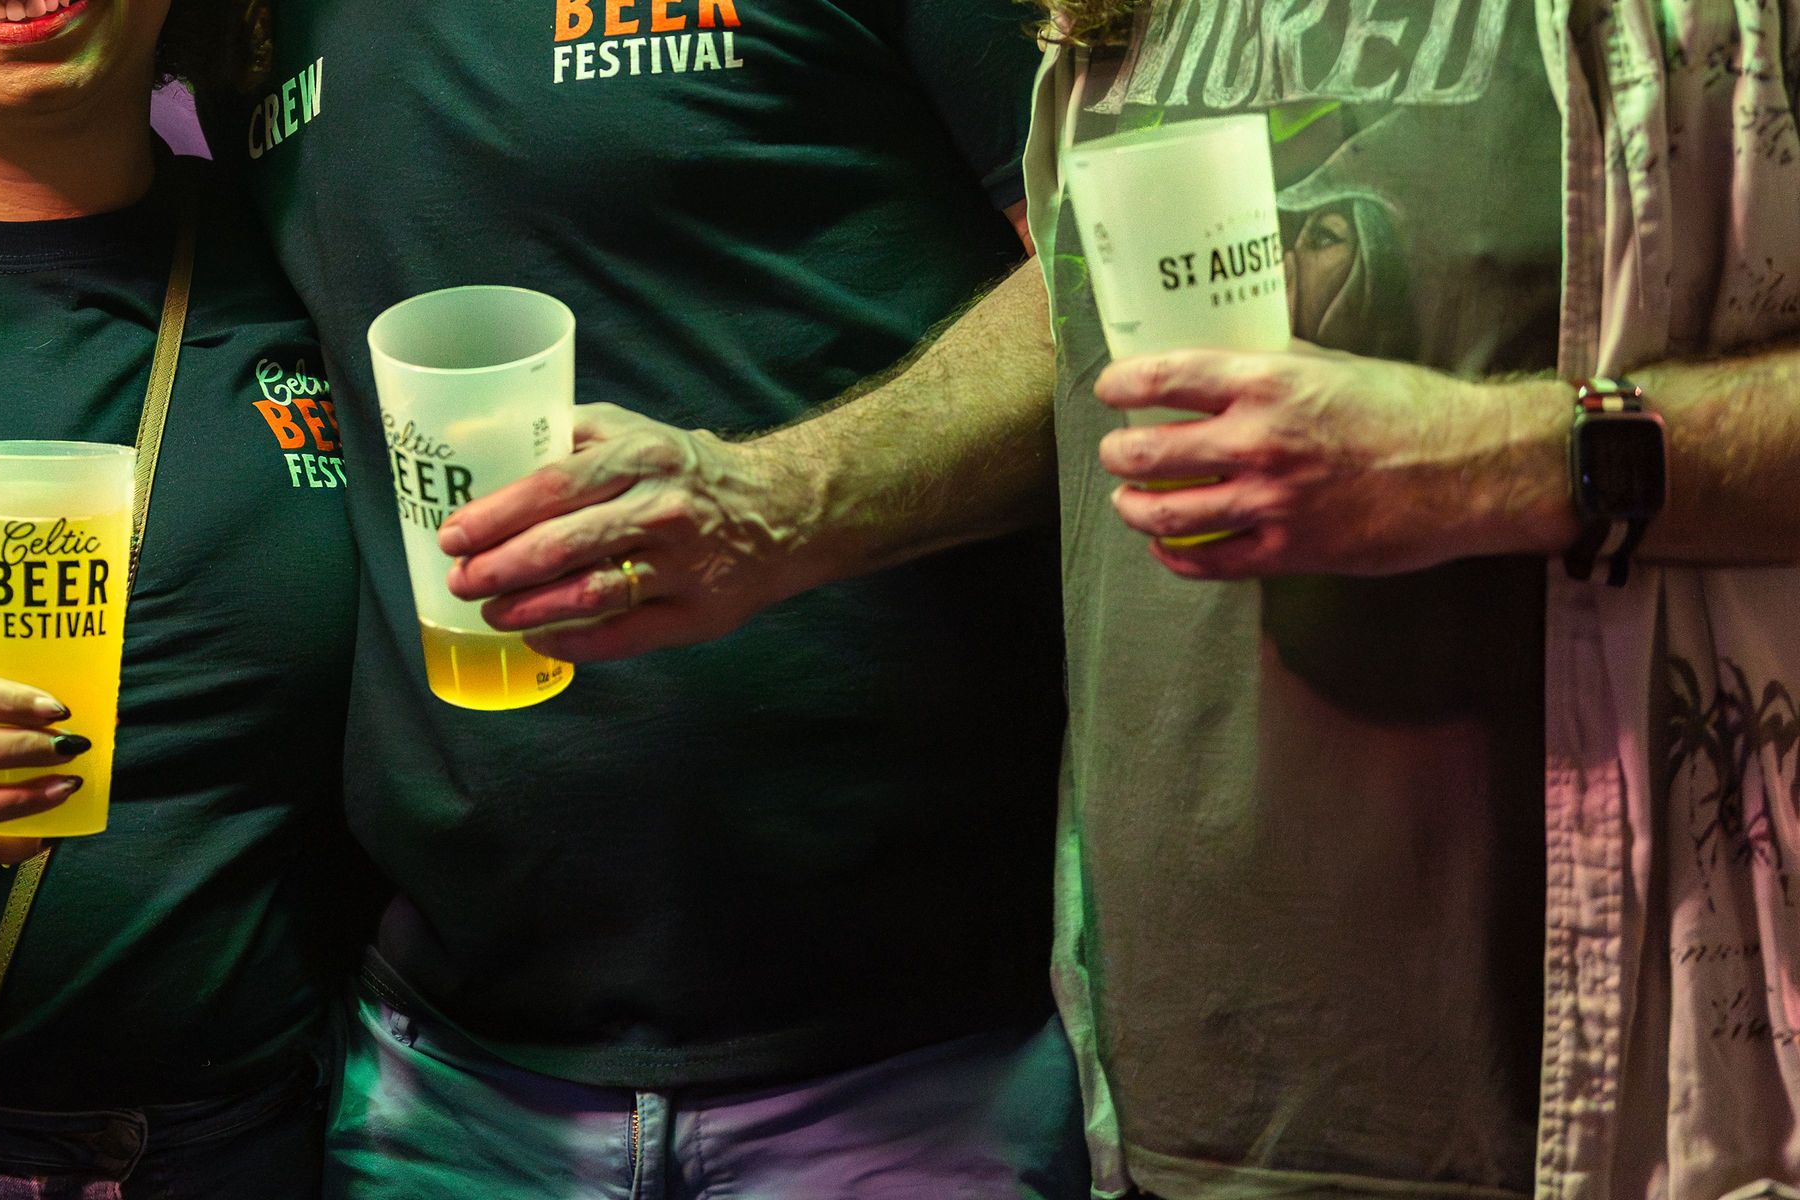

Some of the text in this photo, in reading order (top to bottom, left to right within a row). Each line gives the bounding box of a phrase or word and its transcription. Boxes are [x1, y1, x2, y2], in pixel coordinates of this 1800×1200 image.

[552, 31, 744, 85] FESTIVAL
[248, 56, 324, 160] CREW
[1209, 232, 1283, 283] AUSTE
[283, 453, 348, 489] FEST
[392, 451, 474, 507] EER
[398, 494, 449, 532] STIV
[0, 516, 102, 567] Celtic
